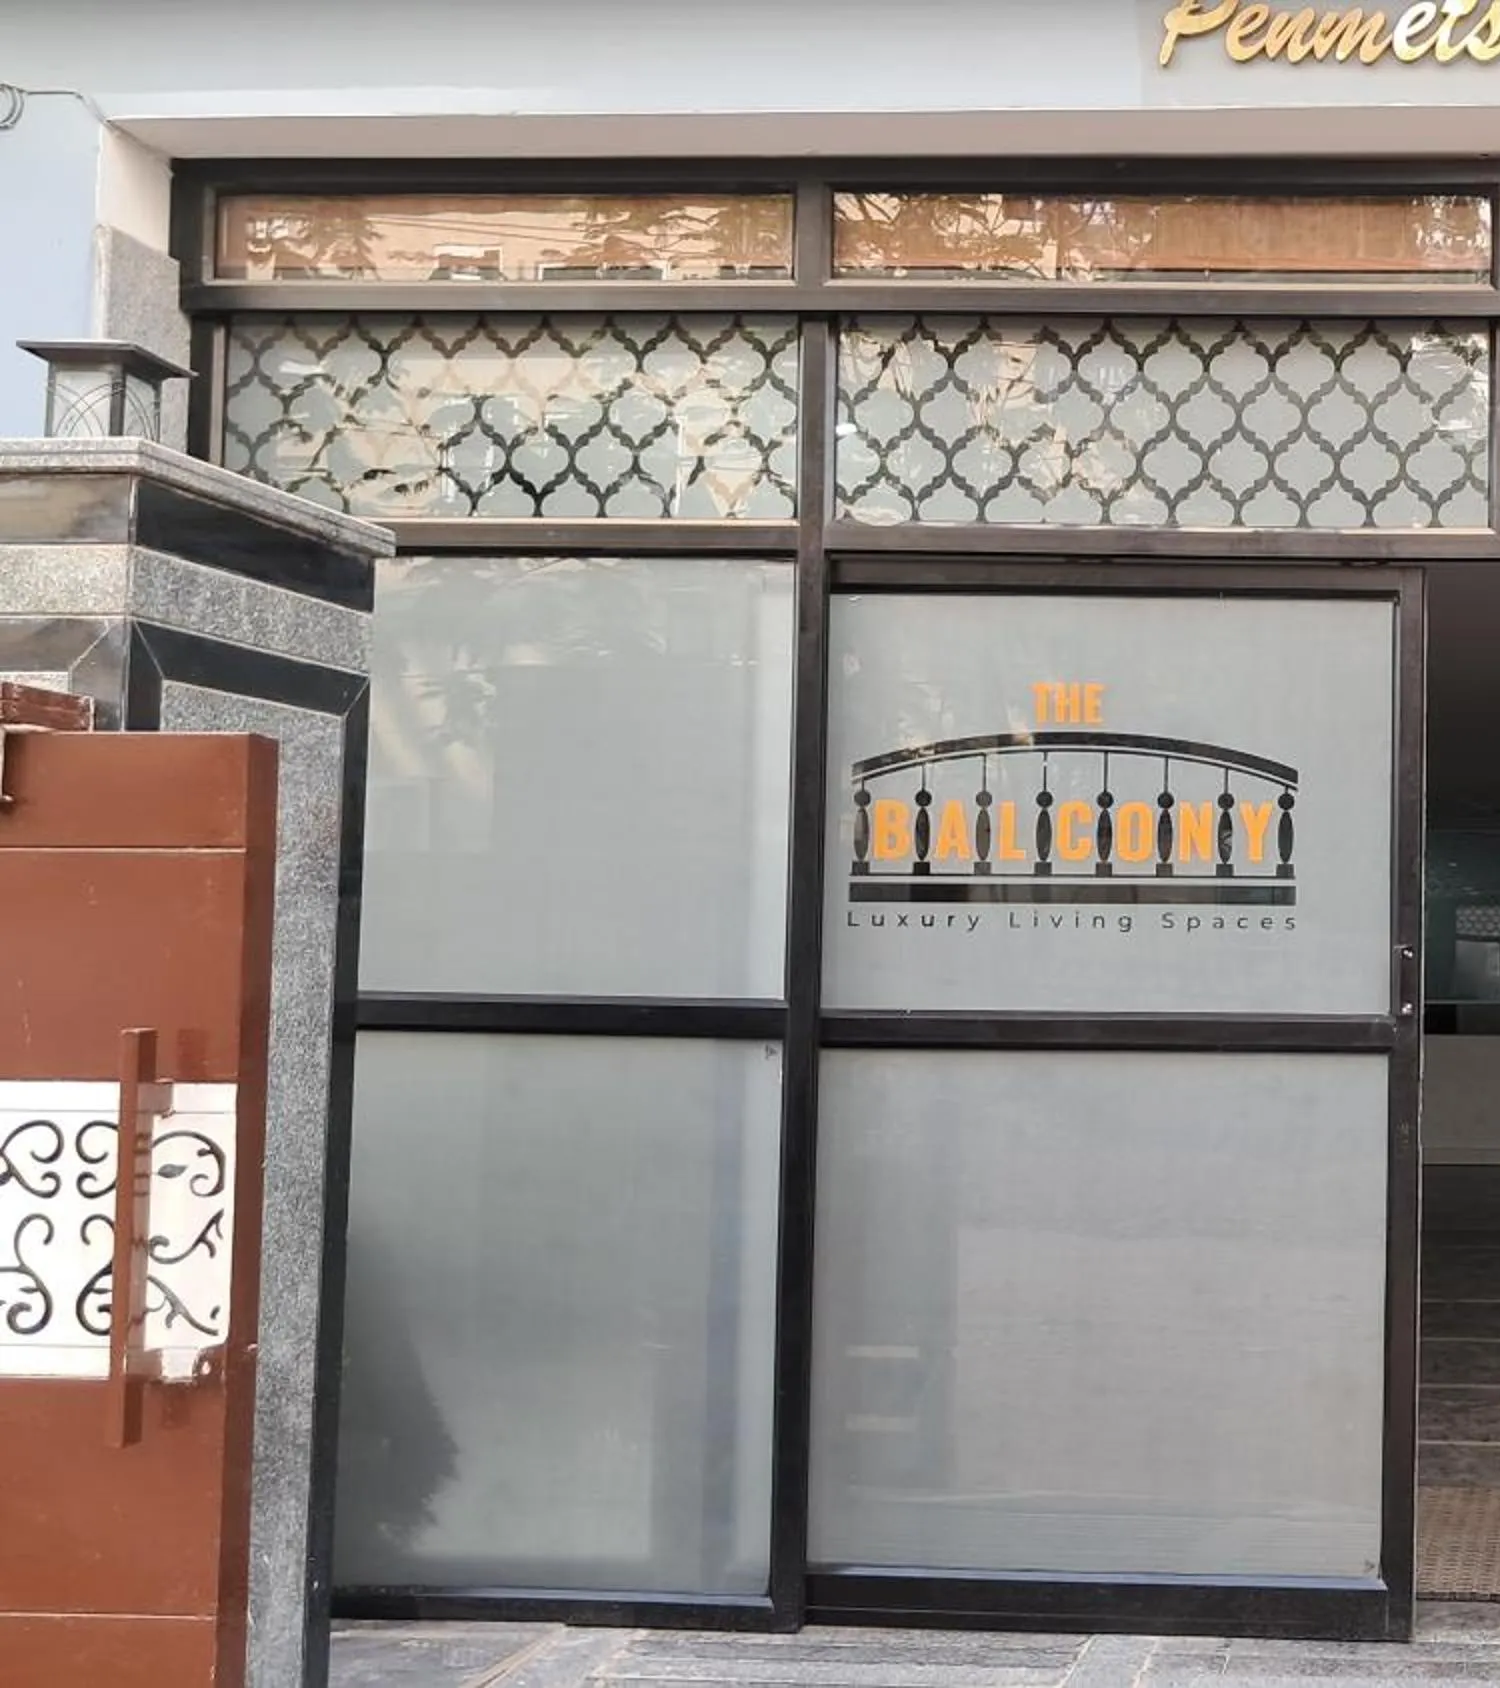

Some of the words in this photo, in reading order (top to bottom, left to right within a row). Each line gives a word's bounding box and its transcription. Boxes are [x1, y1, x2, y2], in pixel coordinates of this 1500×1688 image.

[1031, 682, 1106, 723] THE
[873, 799, 1273, 863] BALCONY
[847, 912, 980, 933] Luxury
[1008, 913, 1133, 933] Living
[1161, 913, 1297, 933] Spaces
